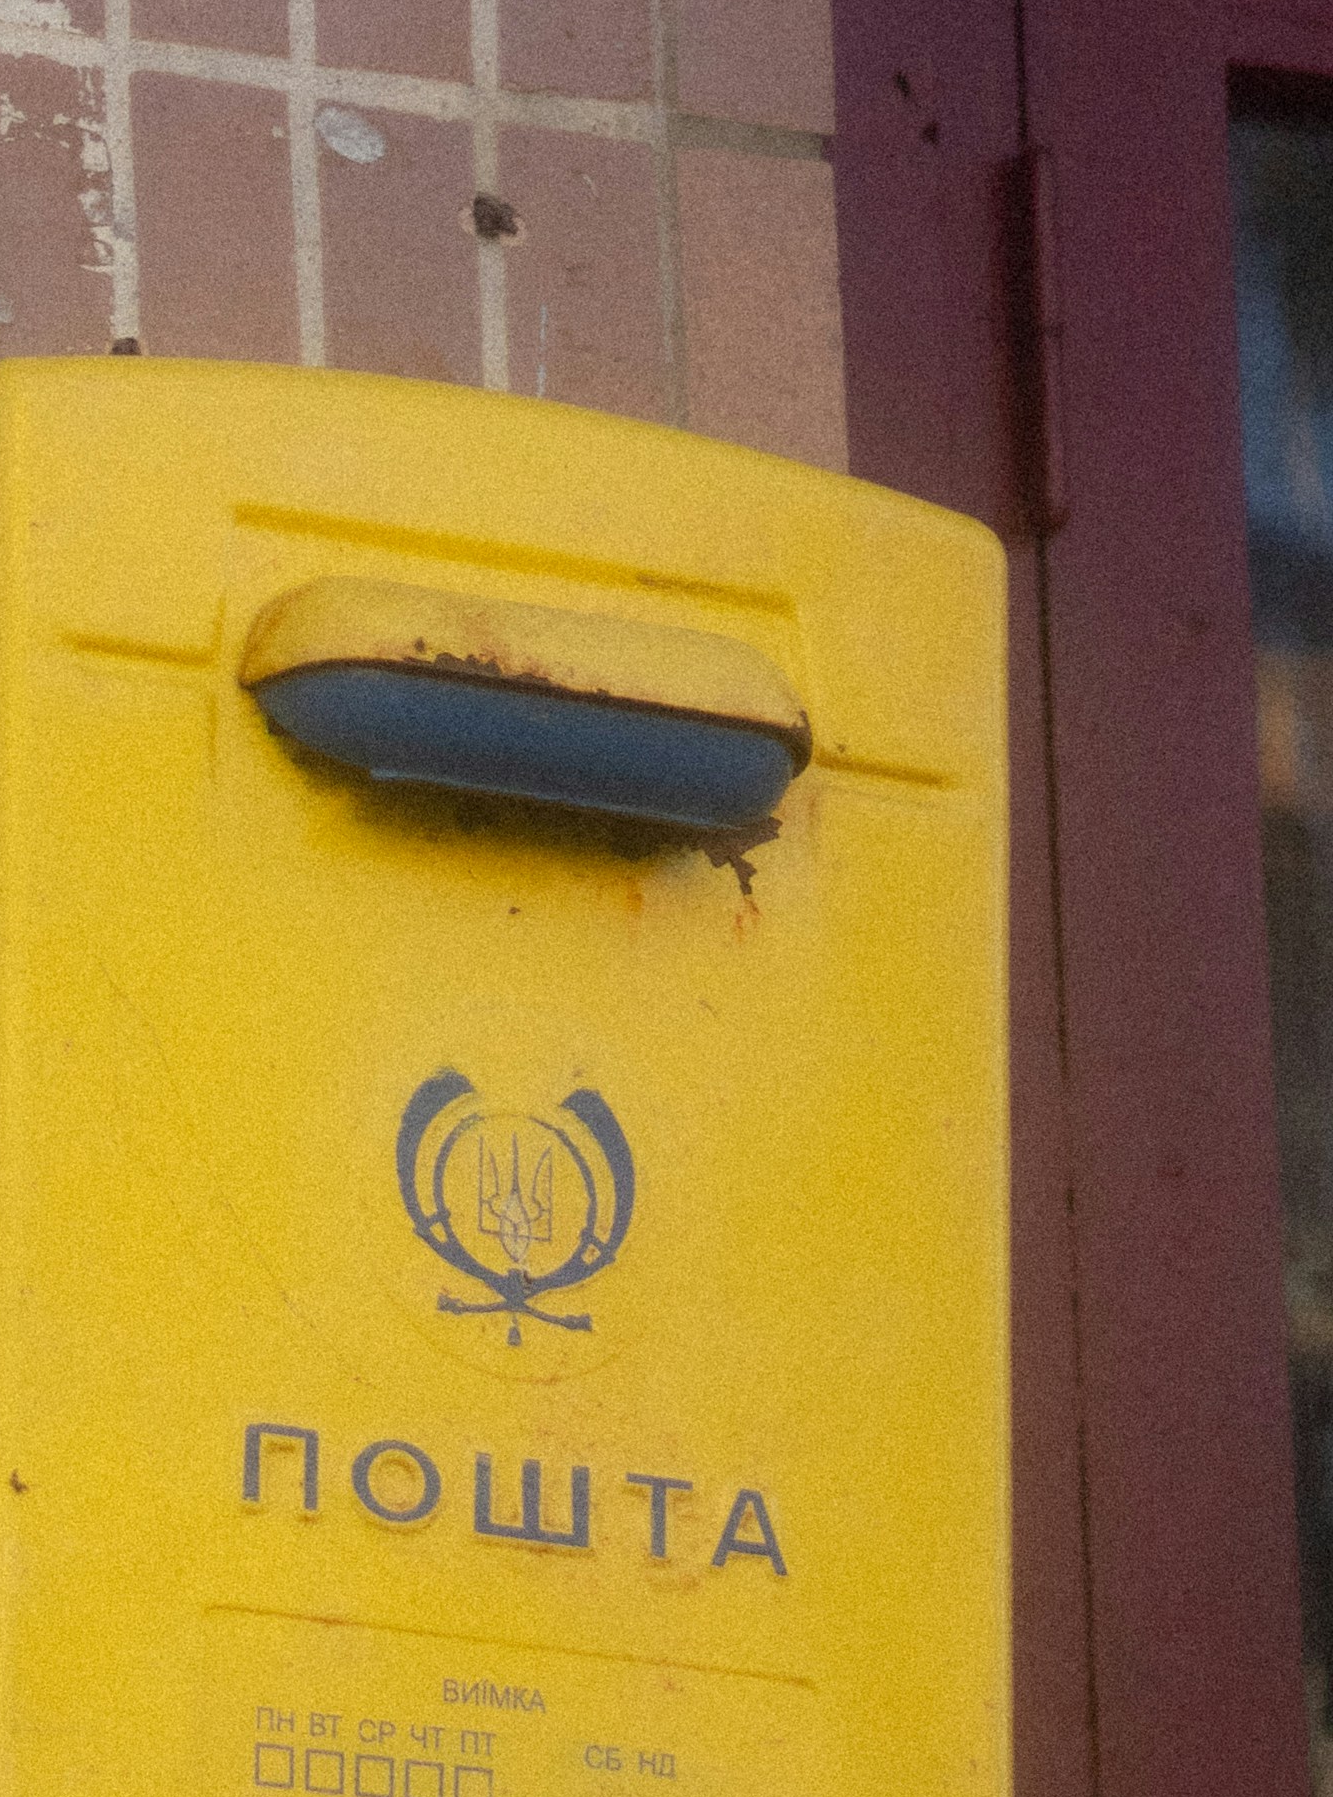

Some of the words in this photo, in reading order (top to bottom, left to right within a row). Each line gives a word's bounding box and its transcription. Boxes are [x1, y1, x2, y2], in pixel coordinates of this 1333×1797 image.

[241, 1422, 788, 1577] ПОШТА
[442, 1677, 547, 1715] ВИЇМКА
[255, 1706, 296, 1735] ПН
[308, 1710, 343, 1740] ВТ
[357, 1718, 396, 1746] СР
[409, 1724, 445, 1752] ЧТ
[459, 1729, 497, 1759] ПТ
[584, 1743, 623, 1773] СБ
[638, 1748, 677, 1782] НД
